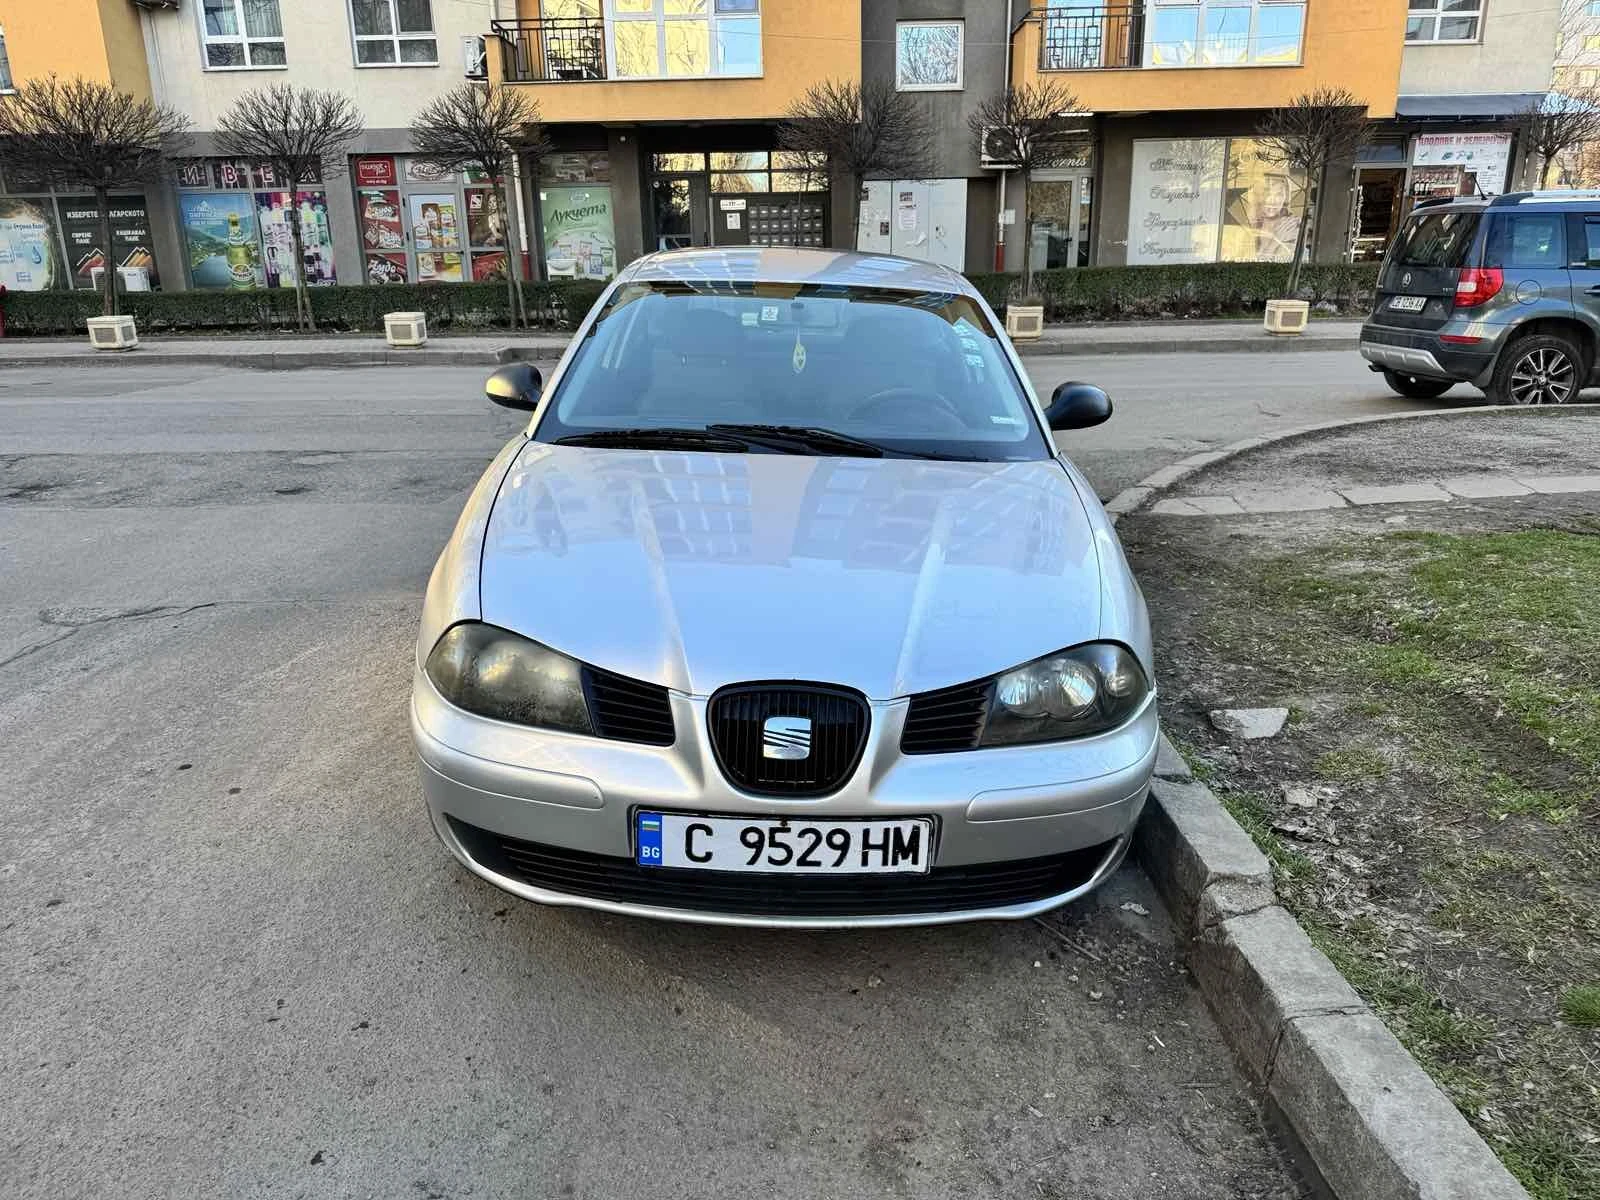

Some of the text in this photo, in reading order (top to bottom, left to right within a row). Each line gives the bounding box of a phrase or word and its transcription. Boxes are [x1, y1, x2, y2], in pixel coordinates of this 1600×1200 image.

[551, 203, 608, 224] Лукчета
[642, 846, 660, 858] BG
[685, 822, 921, 867] C 9529 HM
